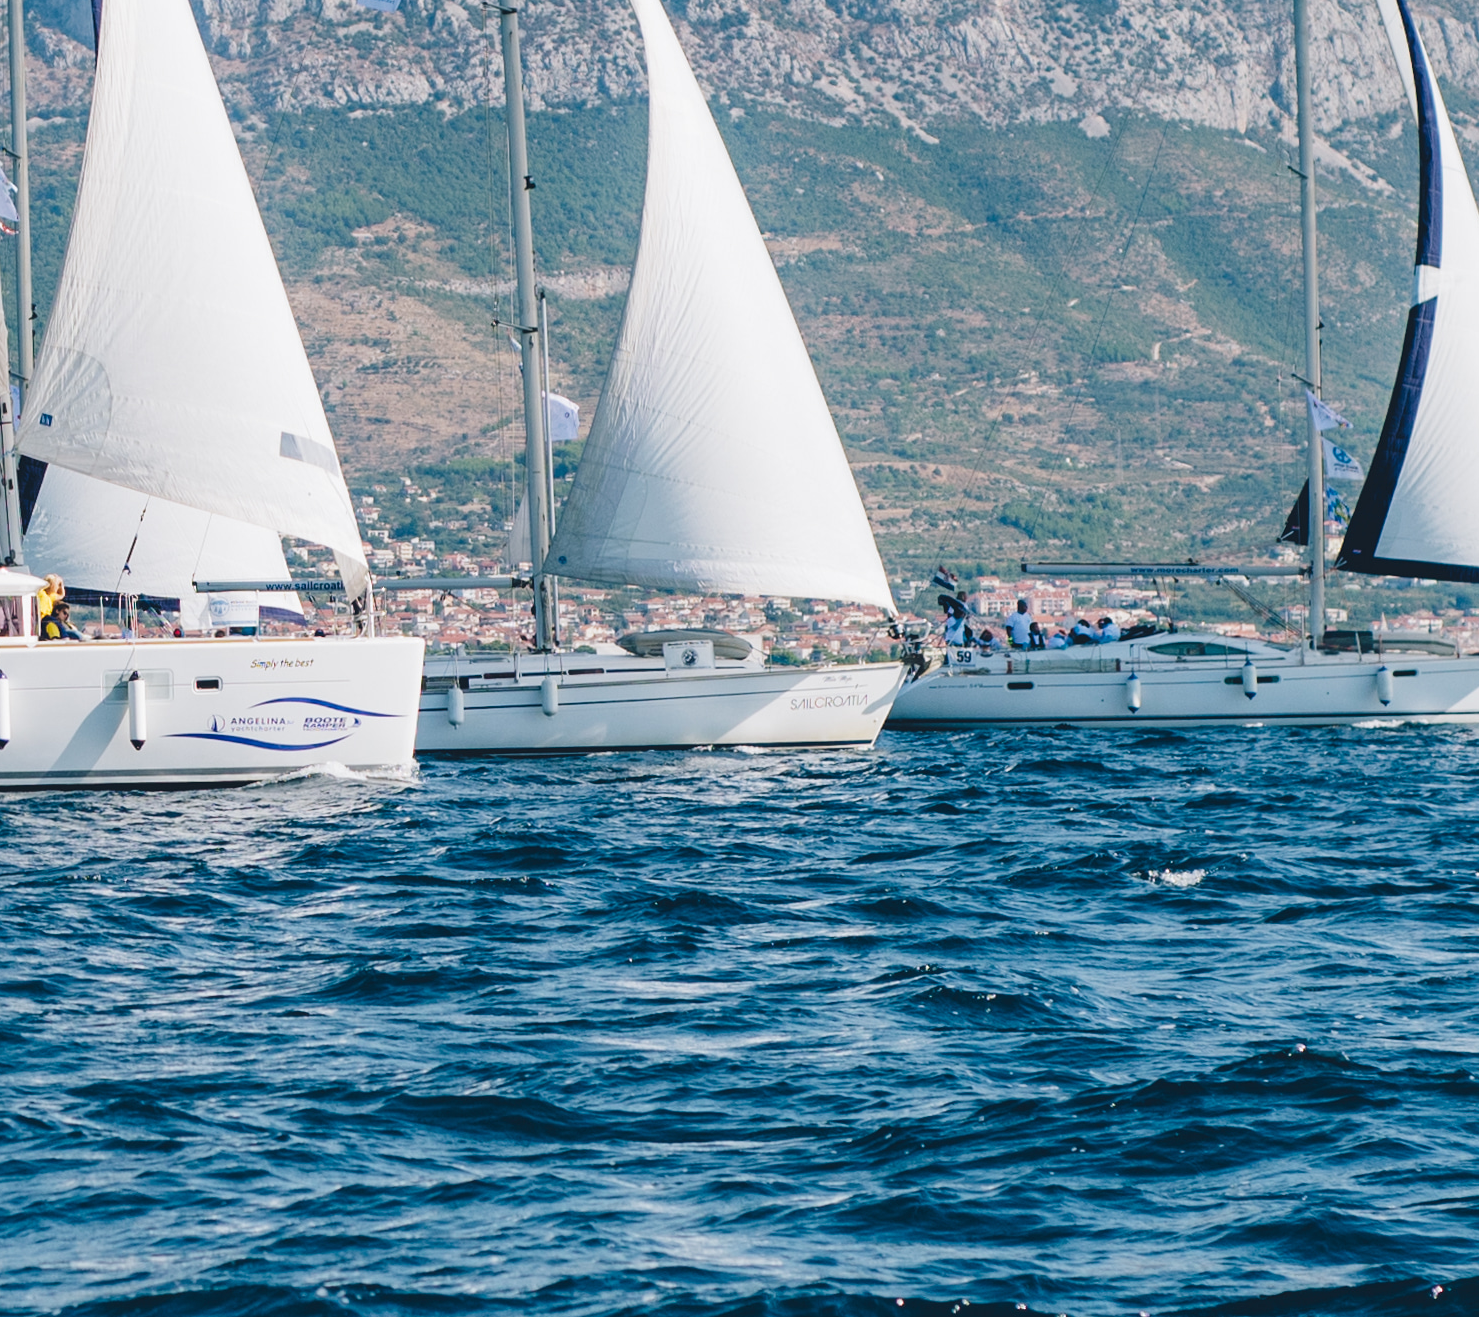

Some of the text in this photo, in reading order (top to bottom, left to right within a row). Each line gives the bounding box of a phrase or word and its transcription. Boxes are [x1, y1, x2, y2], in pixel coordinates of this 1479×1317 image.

[957, 650, 972, 663] 59
[250, 657, 314, 671] Simply the best
[790, 694, 868, 711] SAILCROATIA
[231, 717, 286, 725] ANGELINA
